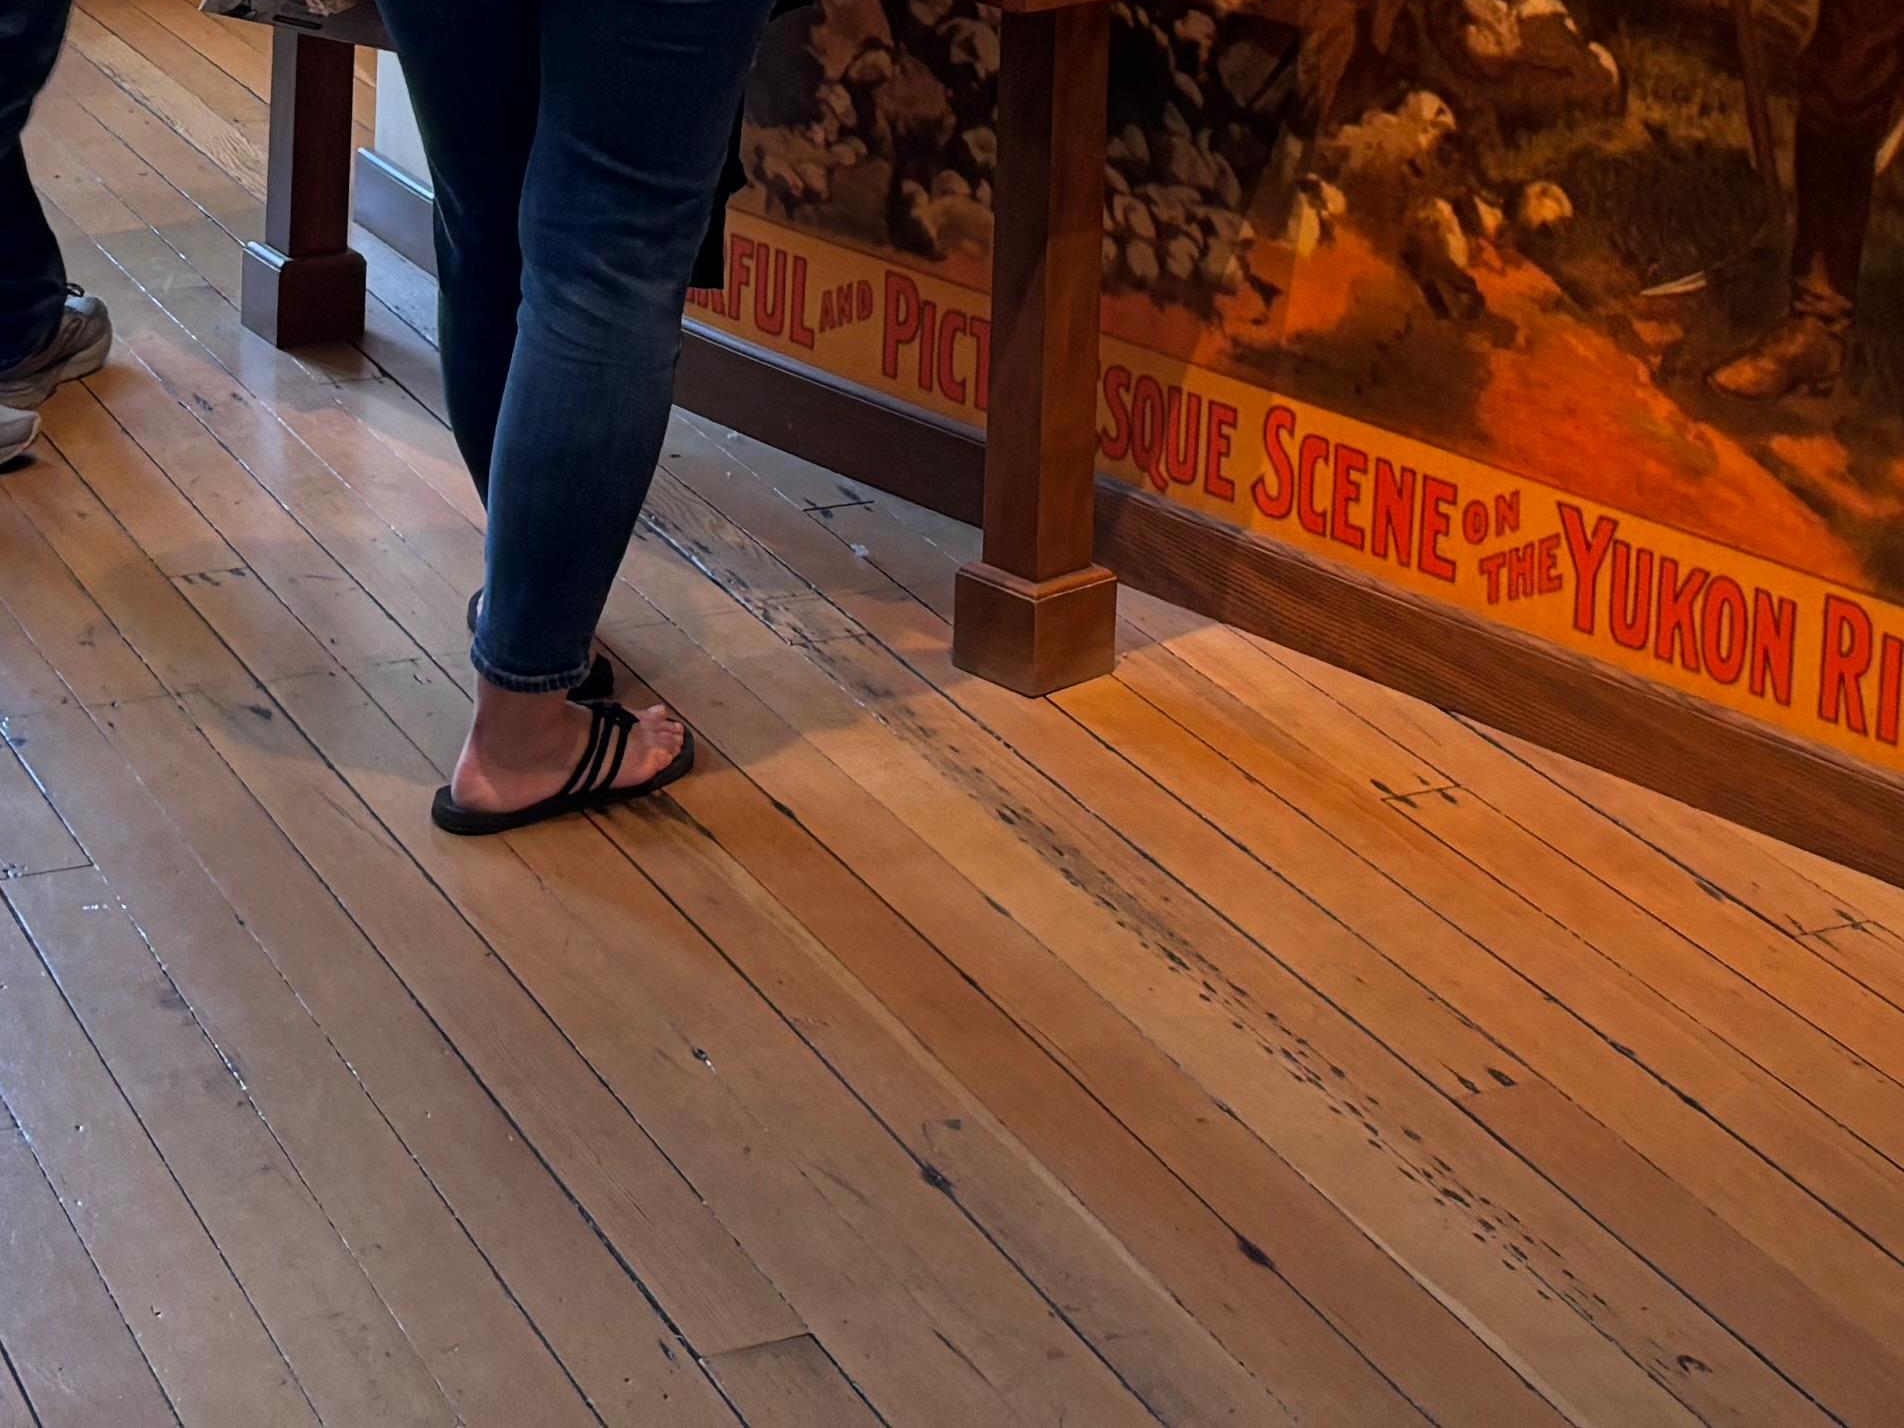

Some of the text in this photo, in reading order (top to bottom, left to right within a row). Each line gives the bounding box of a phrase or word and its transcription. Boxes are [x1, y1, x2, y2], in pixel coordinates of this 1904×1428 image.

[819, 279, 874, 334] AND
[1251, 404, 1457, 583] SCENE
[1462, 490, 1520, 545] ON
[1478, 532, 1563, 605] THE
[1557, 499, 1797, 707] YUKON
